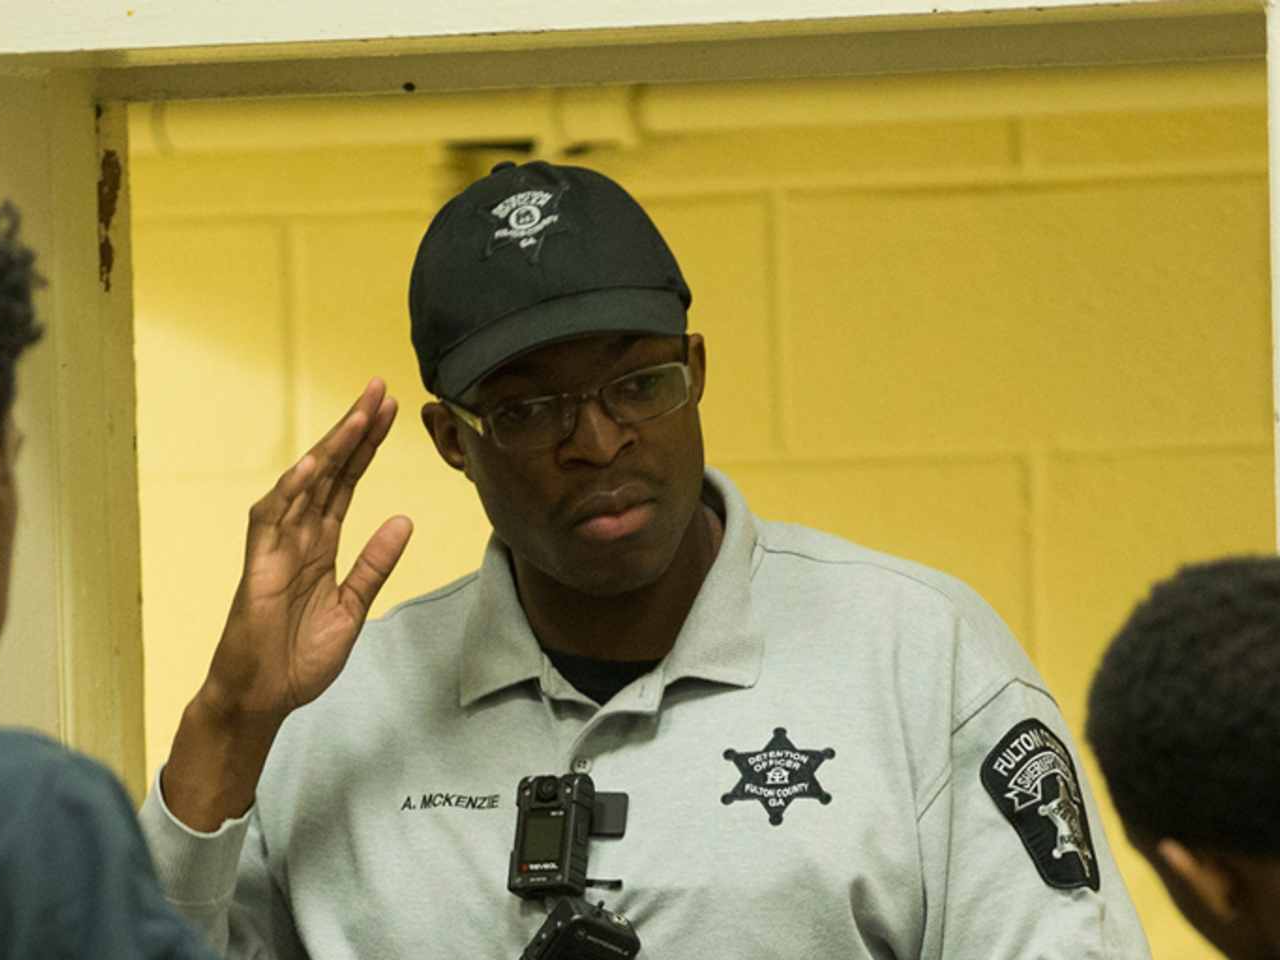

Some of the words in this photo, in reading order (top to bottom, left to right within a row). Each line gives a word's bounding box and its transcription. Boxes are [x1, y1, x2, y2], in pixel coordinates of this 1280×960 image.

[748, 750, 809, 766] DETENTION
[992, 730, 1043, 777] FULTON
[753, 759, 801, 773] OFFICER
[745, 783, 775, 798] FULTON
[776, 782, 809, 798] COUNTY
[401, 795, 416, 811] A.
[420, 792, 500, 811] MCKENZIE
[768, 798, 785, 808] GA
